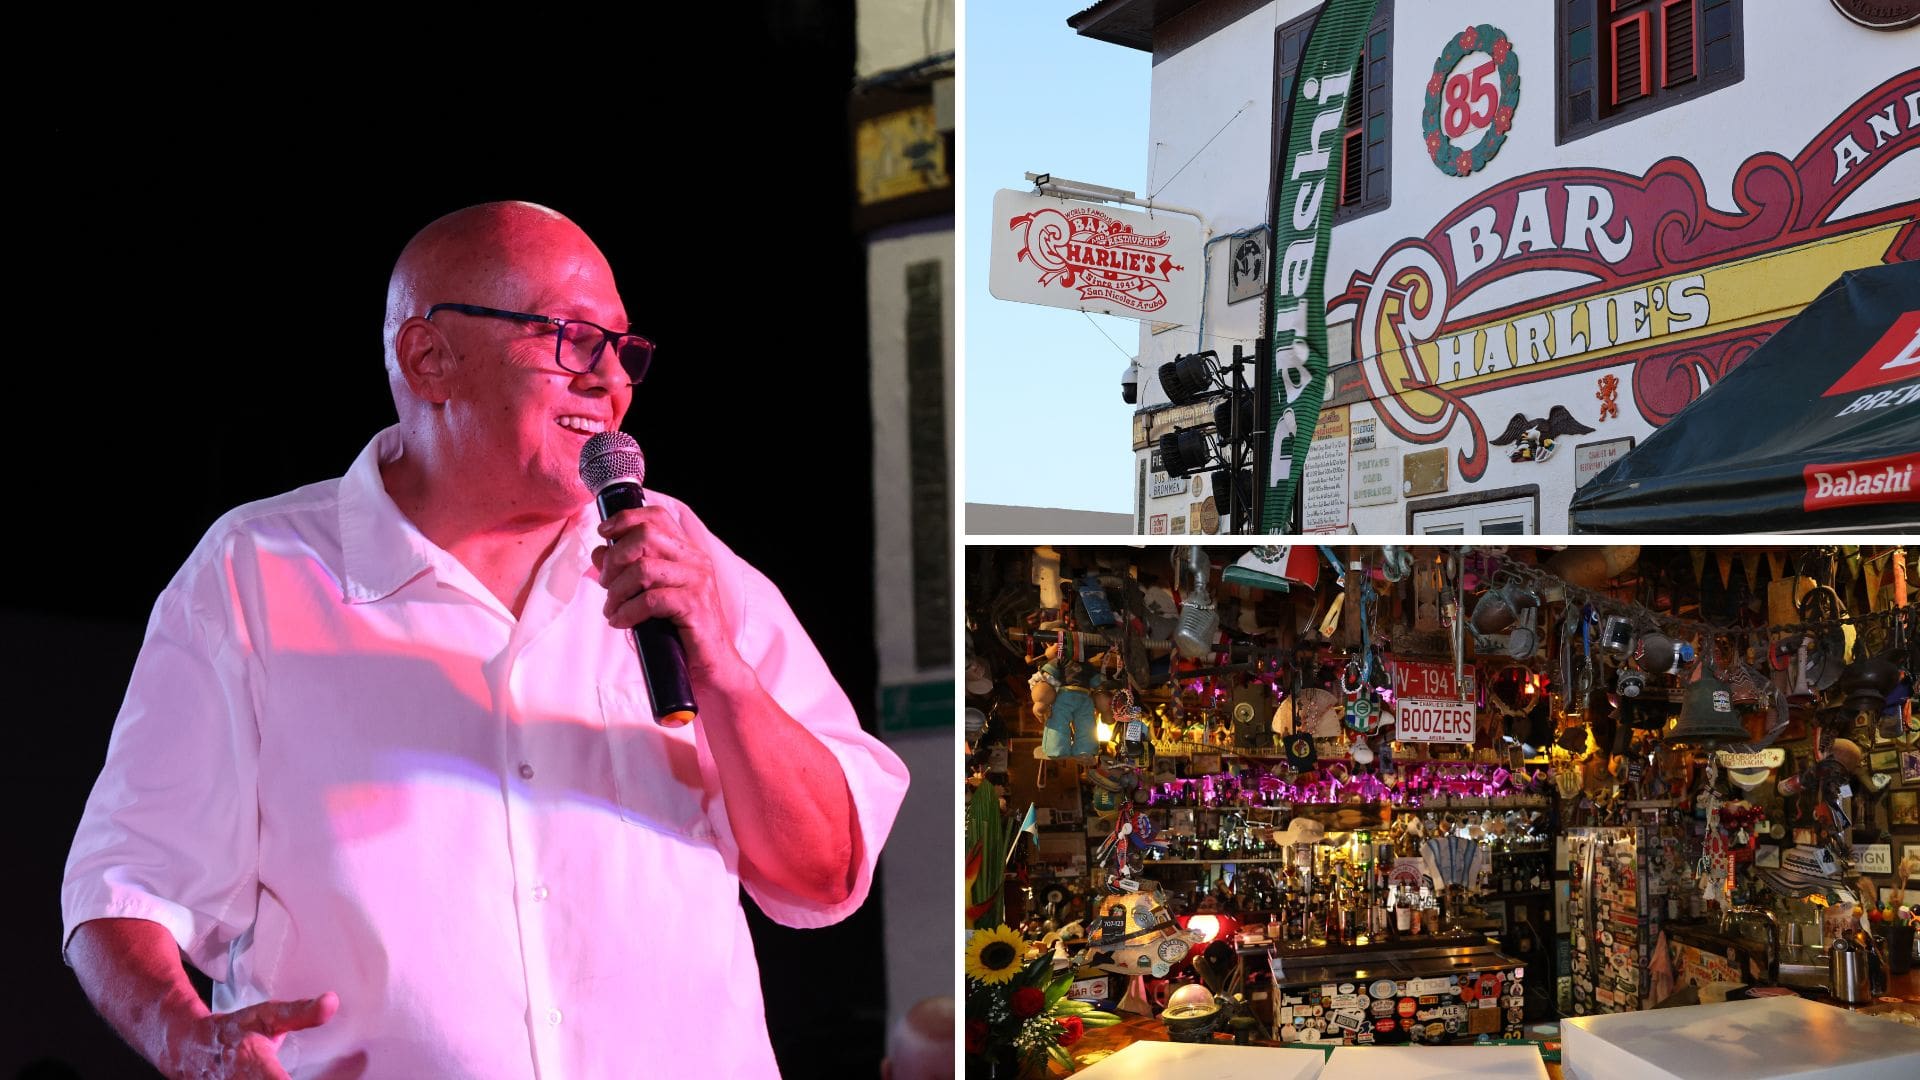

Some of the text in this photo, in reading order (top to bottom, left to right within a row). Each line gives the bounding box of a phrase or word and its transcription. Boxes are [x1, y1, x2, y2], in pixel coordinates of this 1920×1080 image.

[1444, 61, 1499, 138] 85
[1065, 207, 1113, 224] WORLD FAMOUS
[1073, 217, 1110, 236] BAR
[1446, 184, 1633, 288] BAR
[1108, 235, 1162, 247] RESTAURANT
[1116, 281, 1135, 289] 1941
[1086, 287, 1163, 310] San Nicolas Aruba
[1814, 464, 1912, 498] Balashi
[1401, 707, 1472, 735] BOOZERS
[1441, 1007, 1459, 1016] ALE
